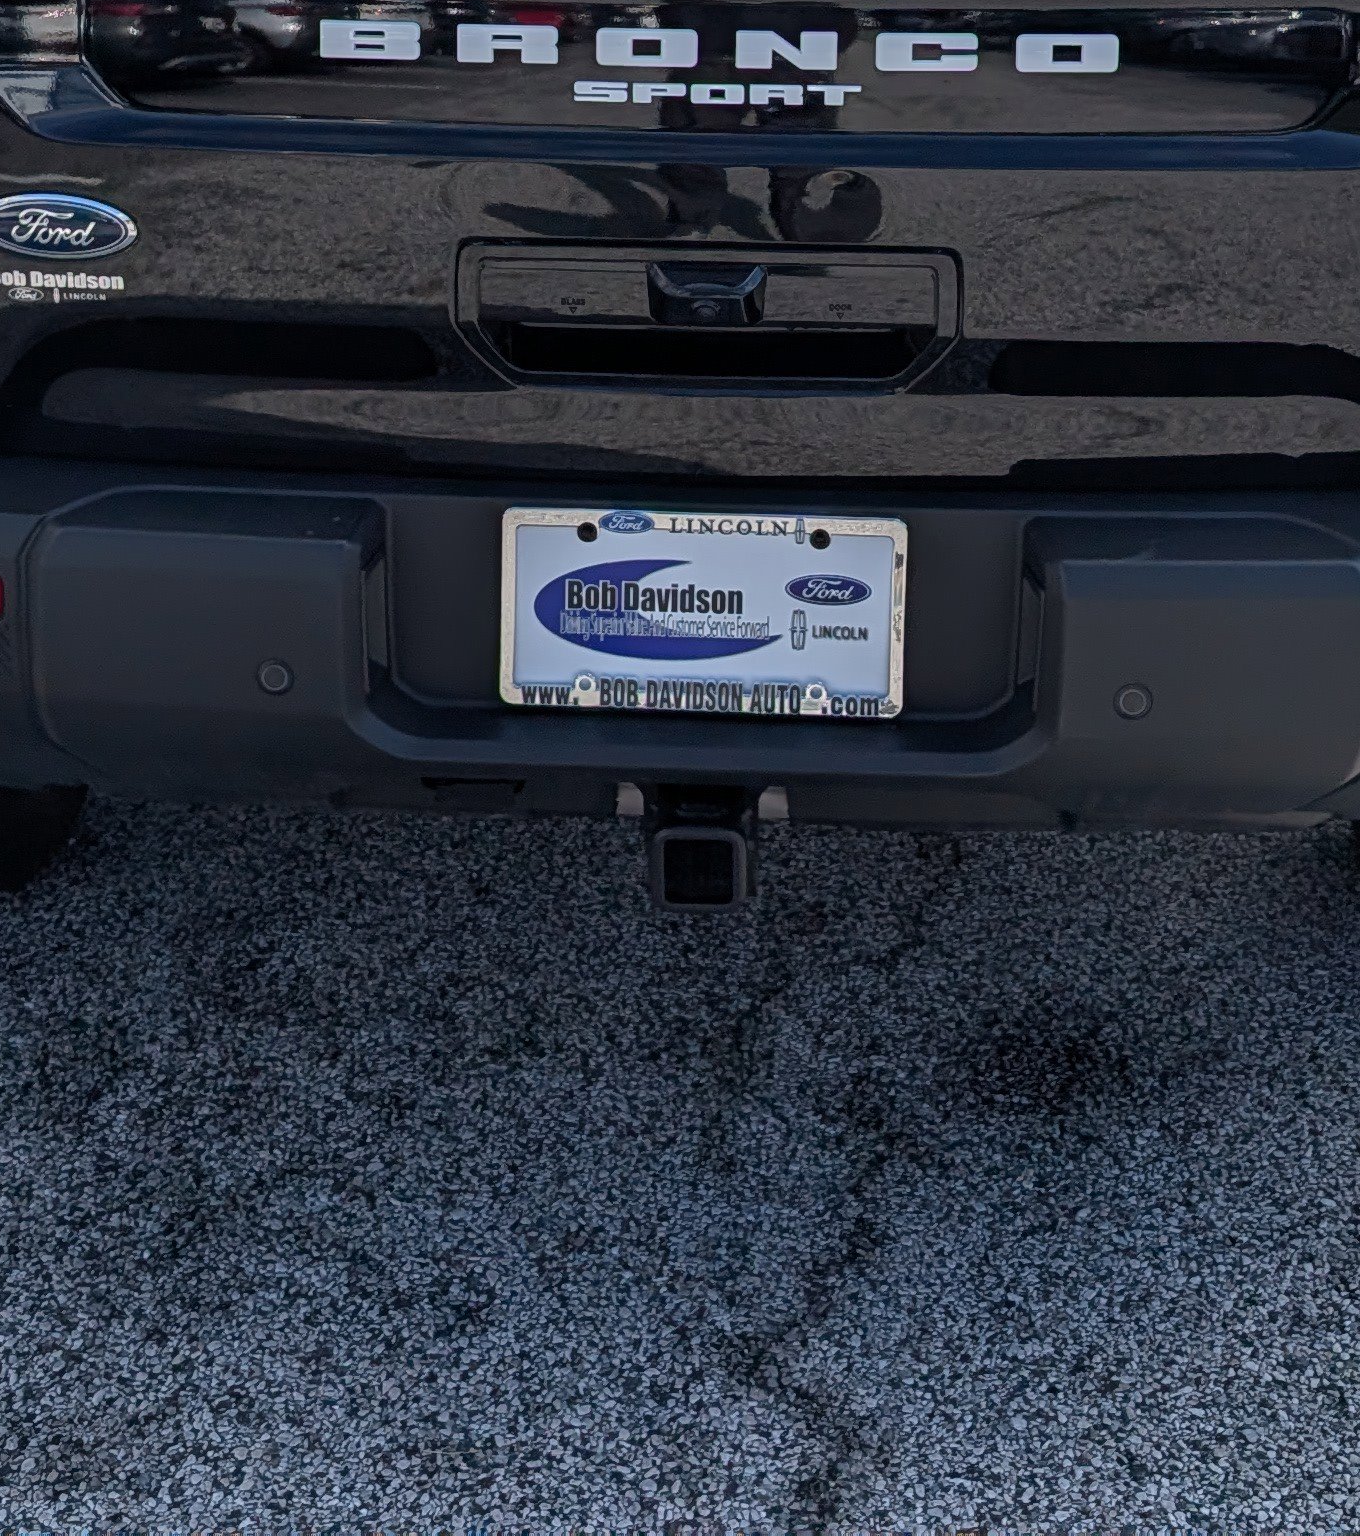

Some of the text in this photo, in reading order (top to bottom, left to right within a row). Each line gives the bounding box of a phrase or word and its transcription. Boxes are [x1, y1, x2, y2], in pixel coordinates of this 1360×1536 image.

[319, 19, 1120, 73] BRONCO
[573, 80, 862, 106] SPORT
[11, 208, 96, 246] Ford
[30, 270, 125, 290] Davidson
[63, 292, 107, 301] LINCOLN
[829, 303, 852, 312] DOOR
[608, 515, 789, 537] Ford LINCOLN
[566, 579, 744, 615] Bob Davidson
[801, 578, 854, 601] Ford
[666, 613, 706, 638] Customer
[706, 614, 736, 638] Service
[736, 615, 770, 640] Forward
[811, 624, 869, 641] LINCOLN
[521, 677, 879, 716] www. BOB DAVIDSON AUTO .com
